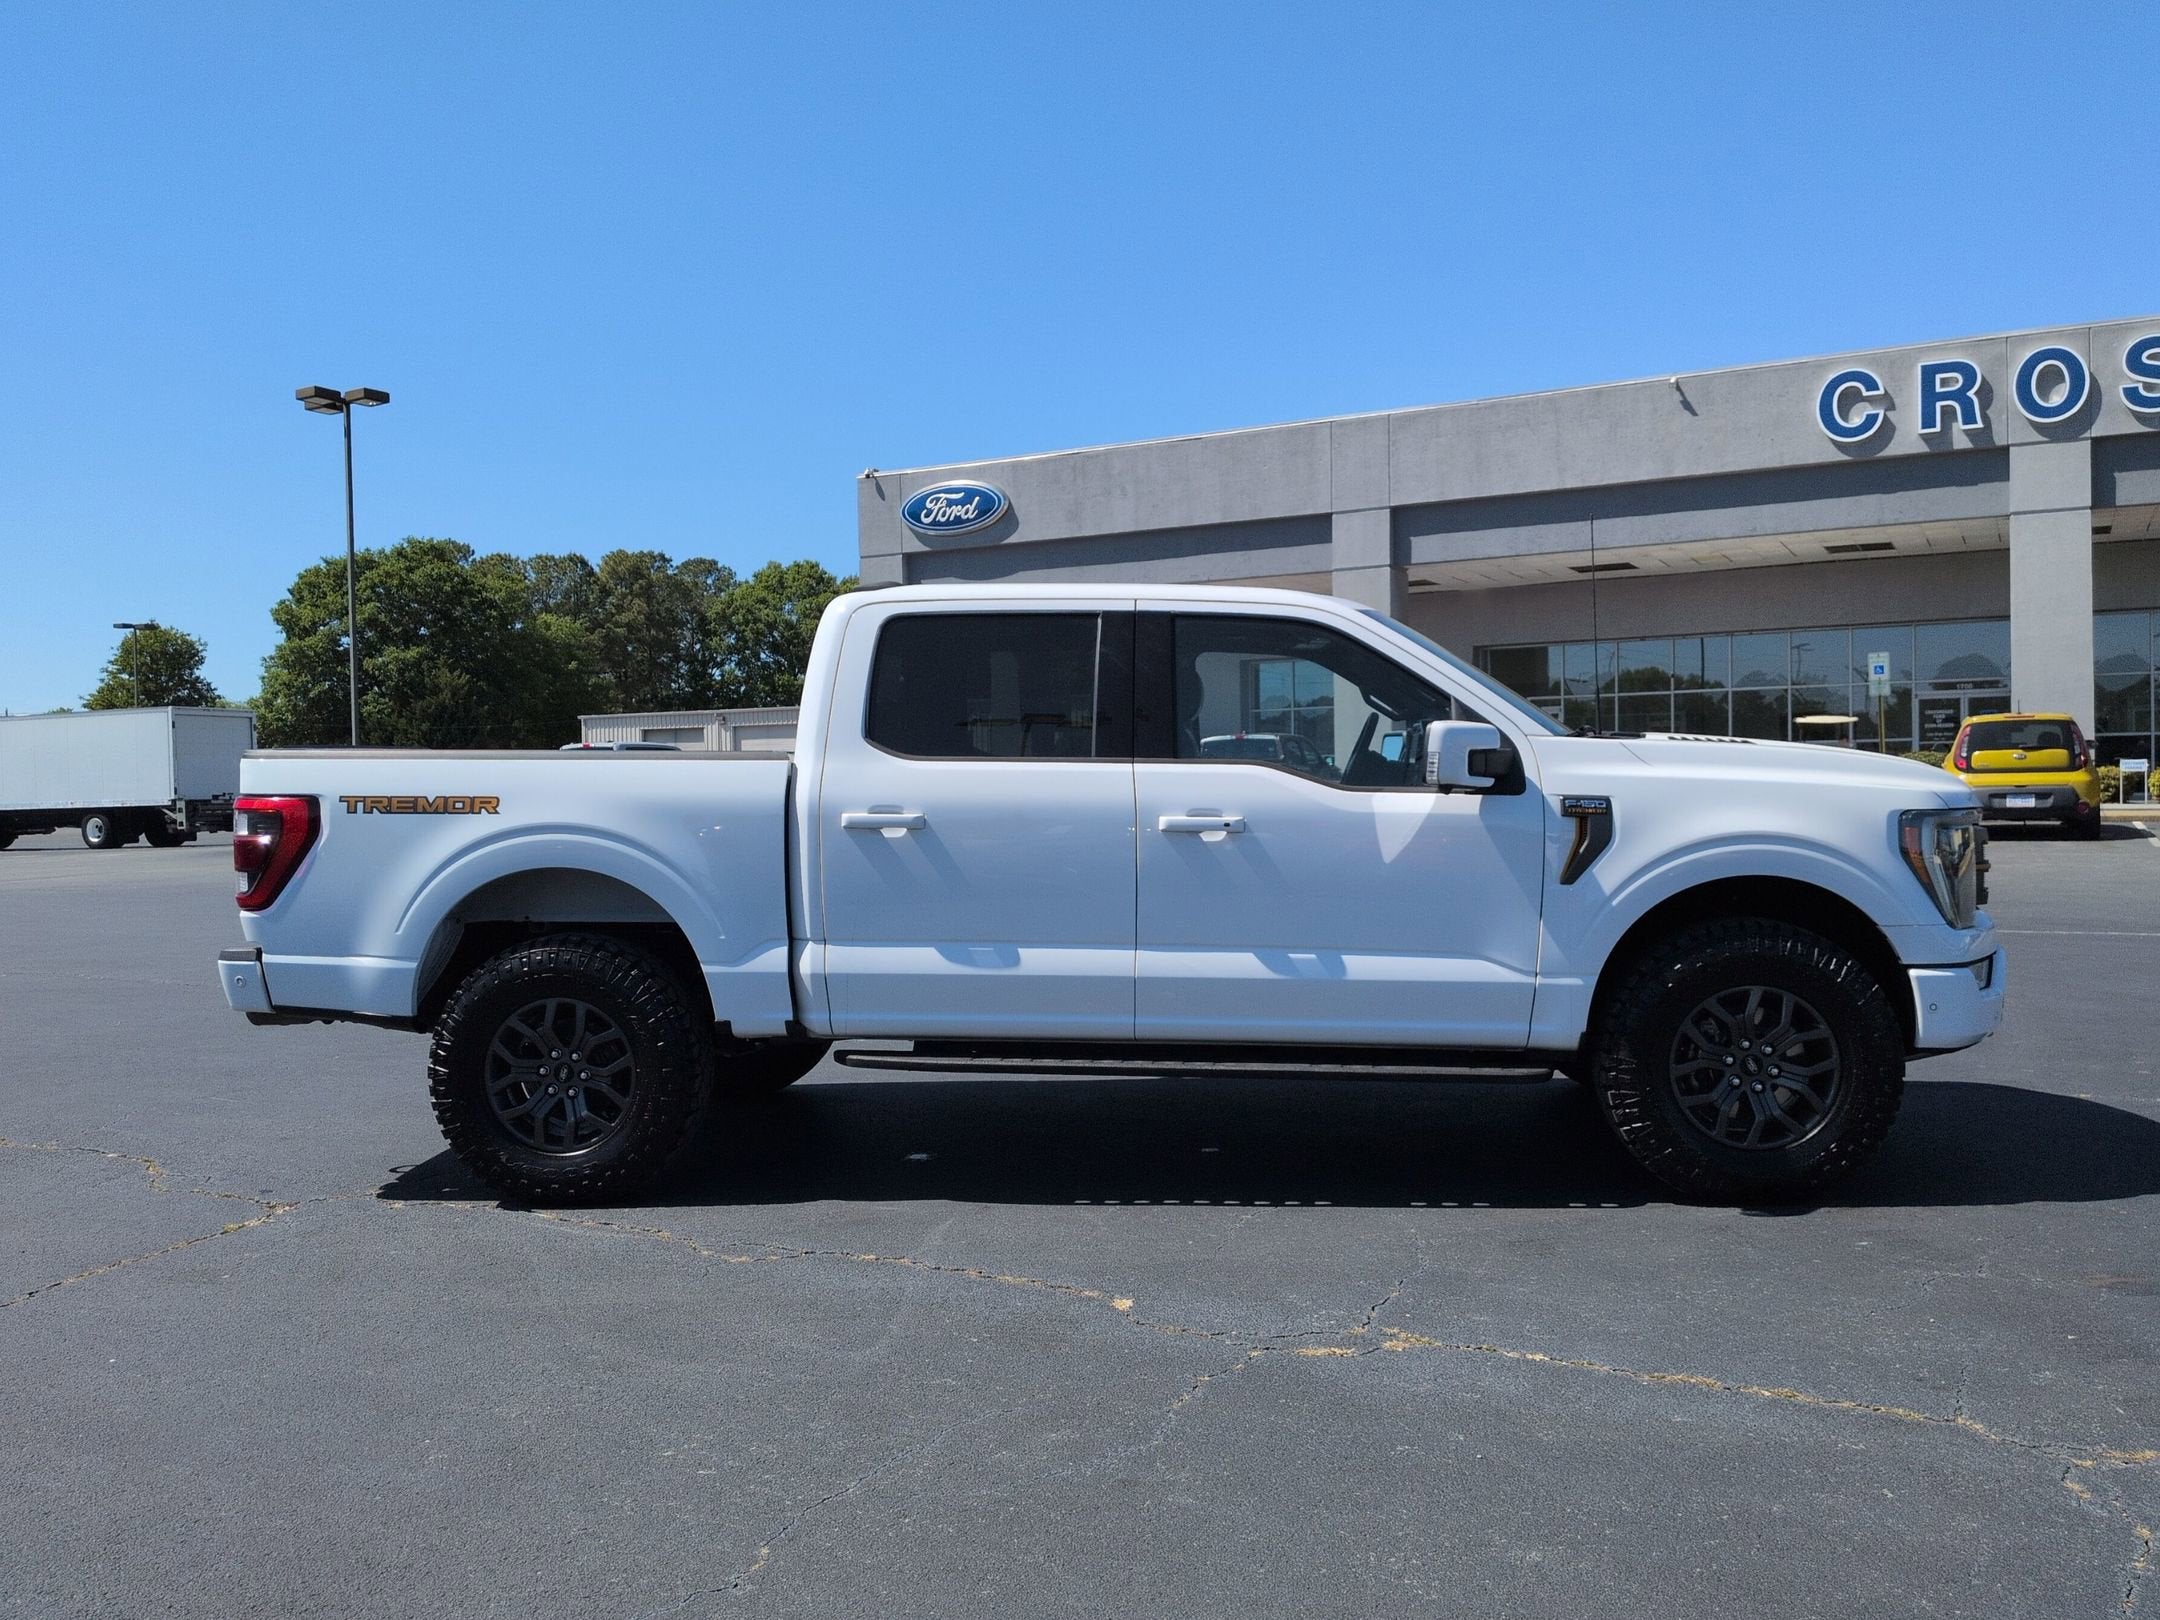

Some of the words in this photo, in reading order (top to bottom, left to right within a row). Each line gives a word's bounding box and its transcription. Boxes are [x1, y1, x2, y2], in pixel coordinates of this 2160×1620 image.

[920, 491, 980, 524] Ford
[338, 795, 501, 814] TREMOR
[1564, 799, 1607, 808] F-150
